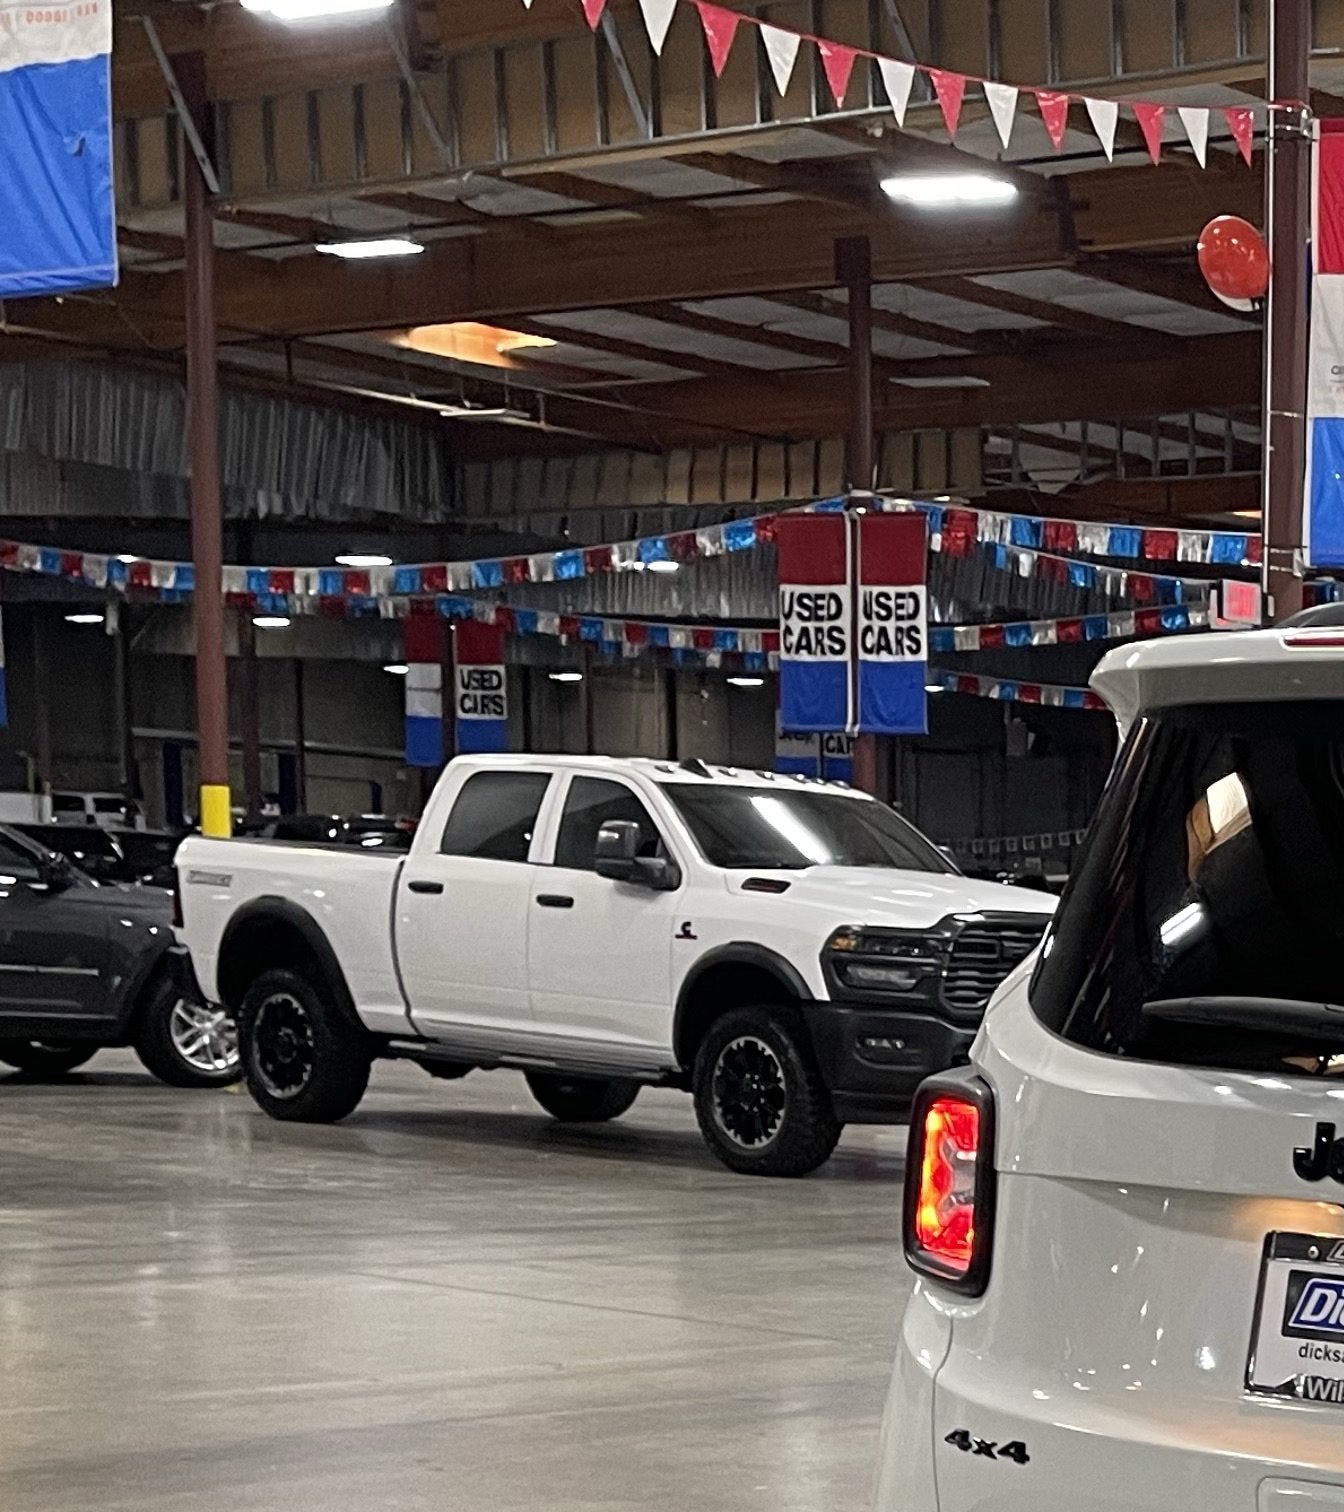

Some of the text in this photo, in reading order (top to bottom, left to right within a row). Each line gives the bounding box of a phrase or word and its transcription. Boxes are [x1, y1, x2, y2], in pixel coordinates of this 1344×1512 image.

[781, 590, 843, 621] USED
[863, 590, 921, 621] USED
[782, 625, 847, 656] CARS
[861, 624, 922, 656] CARS
[459, 668, 503, 691] USED
[944, 1428, 1030, 1466] 4x4
